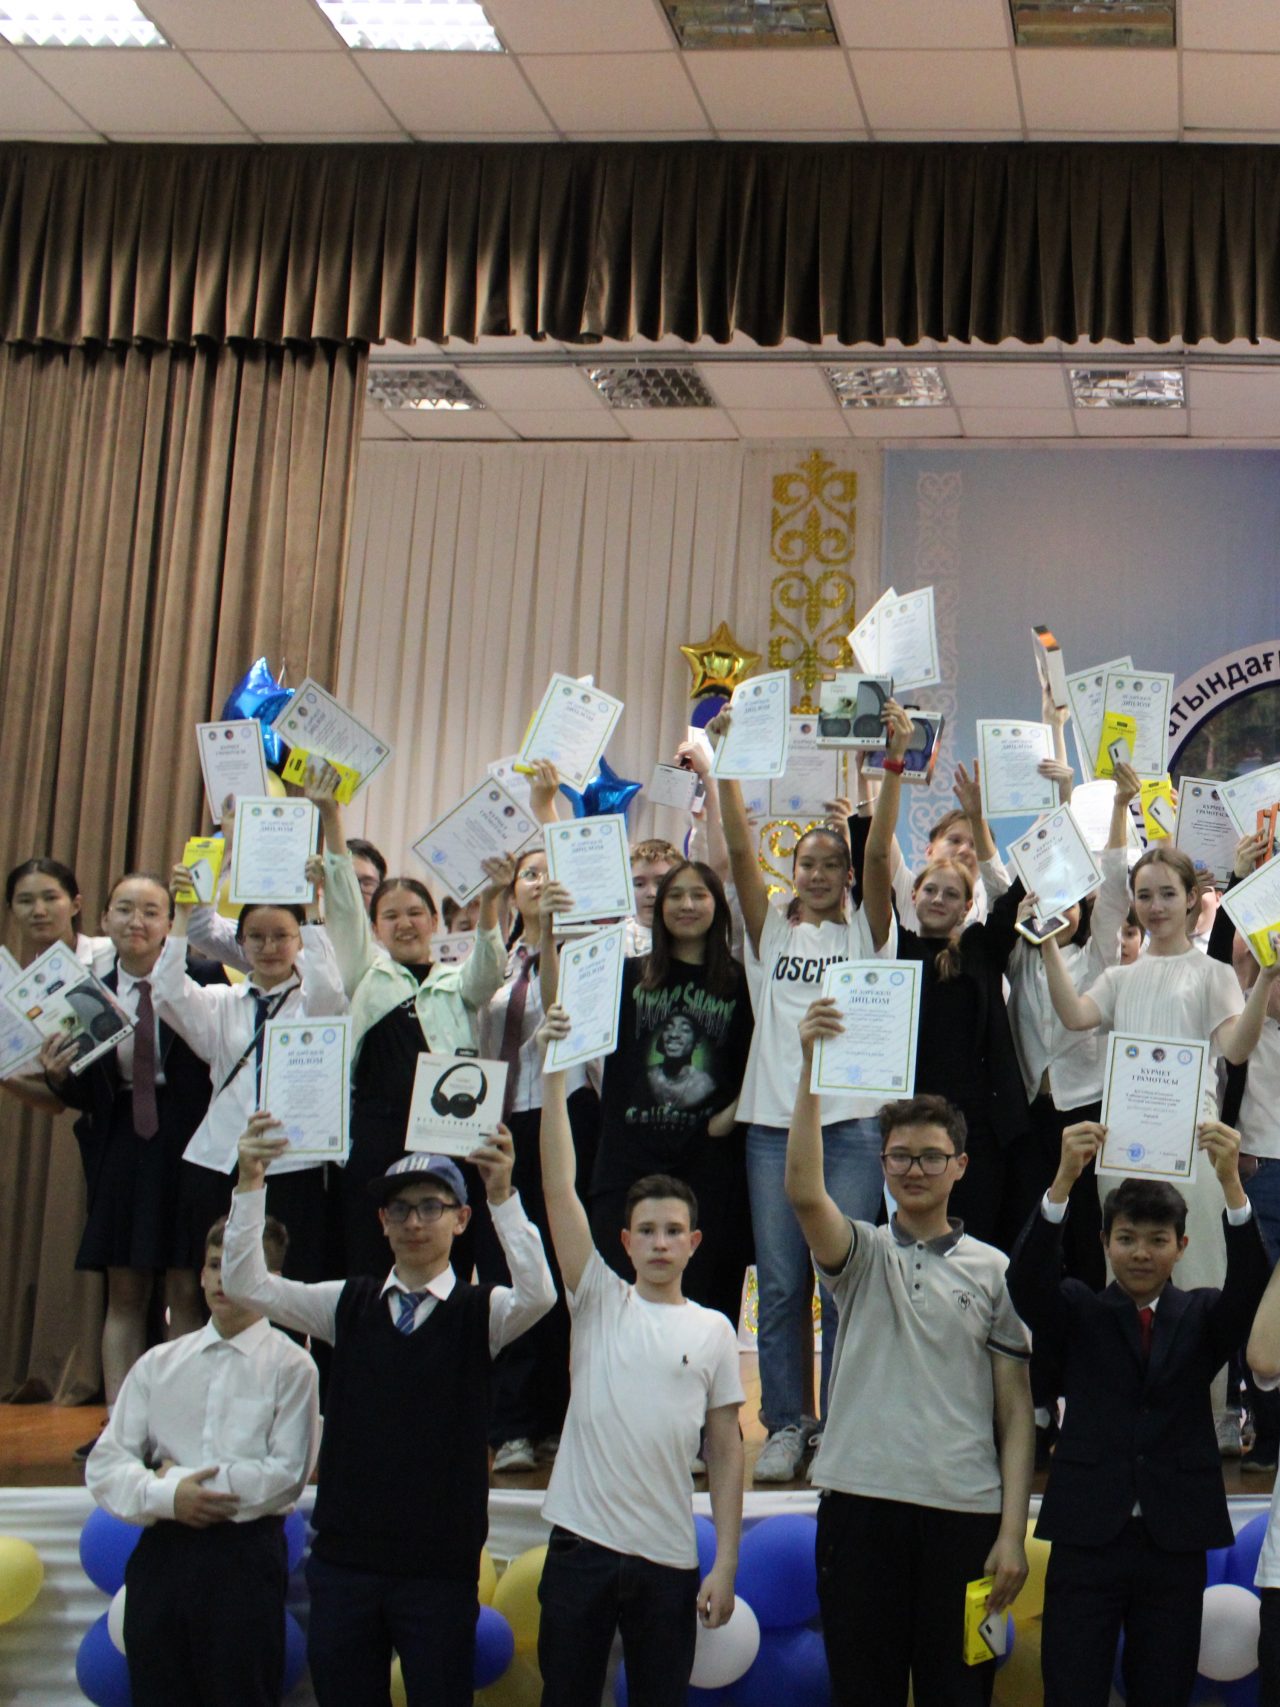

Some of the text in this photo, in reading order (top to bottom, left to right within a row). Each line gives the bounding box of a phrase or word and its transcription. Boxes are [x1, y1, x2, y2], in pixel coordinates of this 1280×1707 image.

[850, 997, 890, 1005] ДИПЛОМ
[287, 1057, 323, 1066] ДИПЛОМ
[1132, 1075, 1178, 1086] ГРАМОТАСЫ
